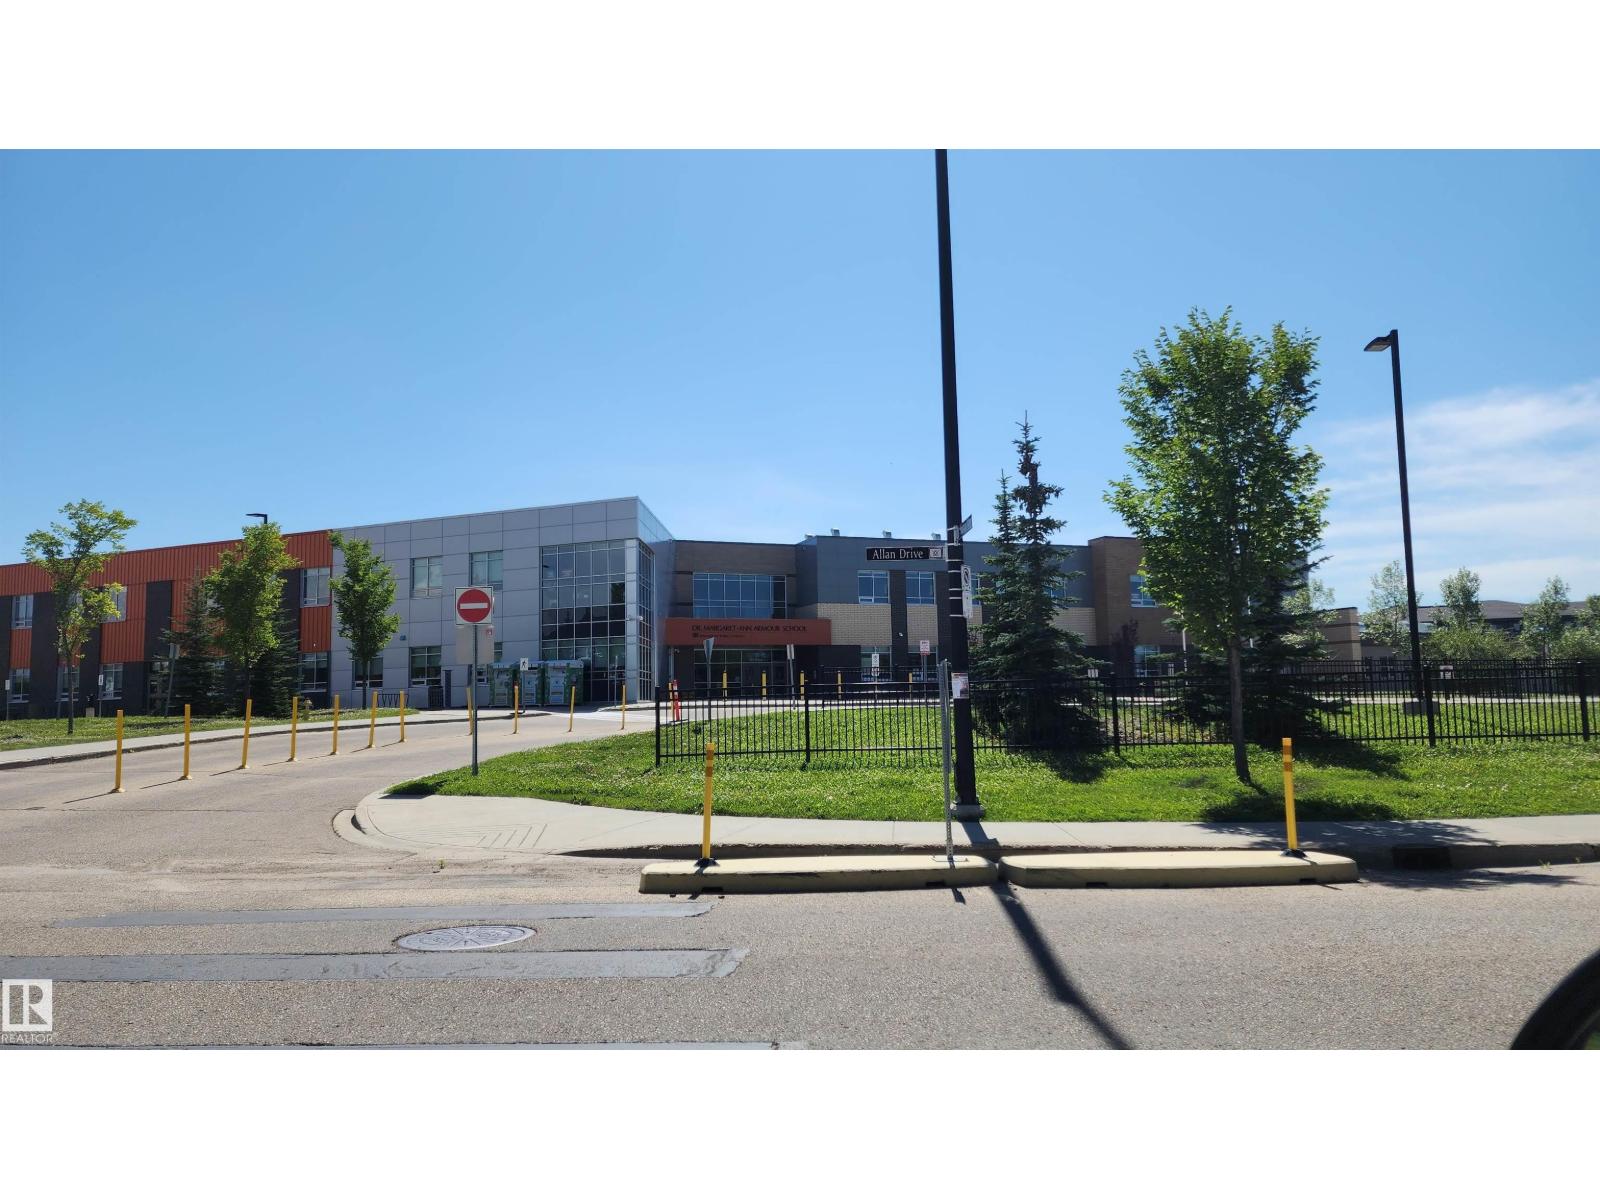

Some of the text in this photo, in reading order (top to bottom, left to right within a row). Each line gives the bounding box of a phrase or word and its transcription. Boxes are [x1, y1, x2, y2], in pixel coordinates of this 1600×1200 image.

[872, 547, 924, 560] Allan Drive
[782, 624, 807, 632] SCHOOL
